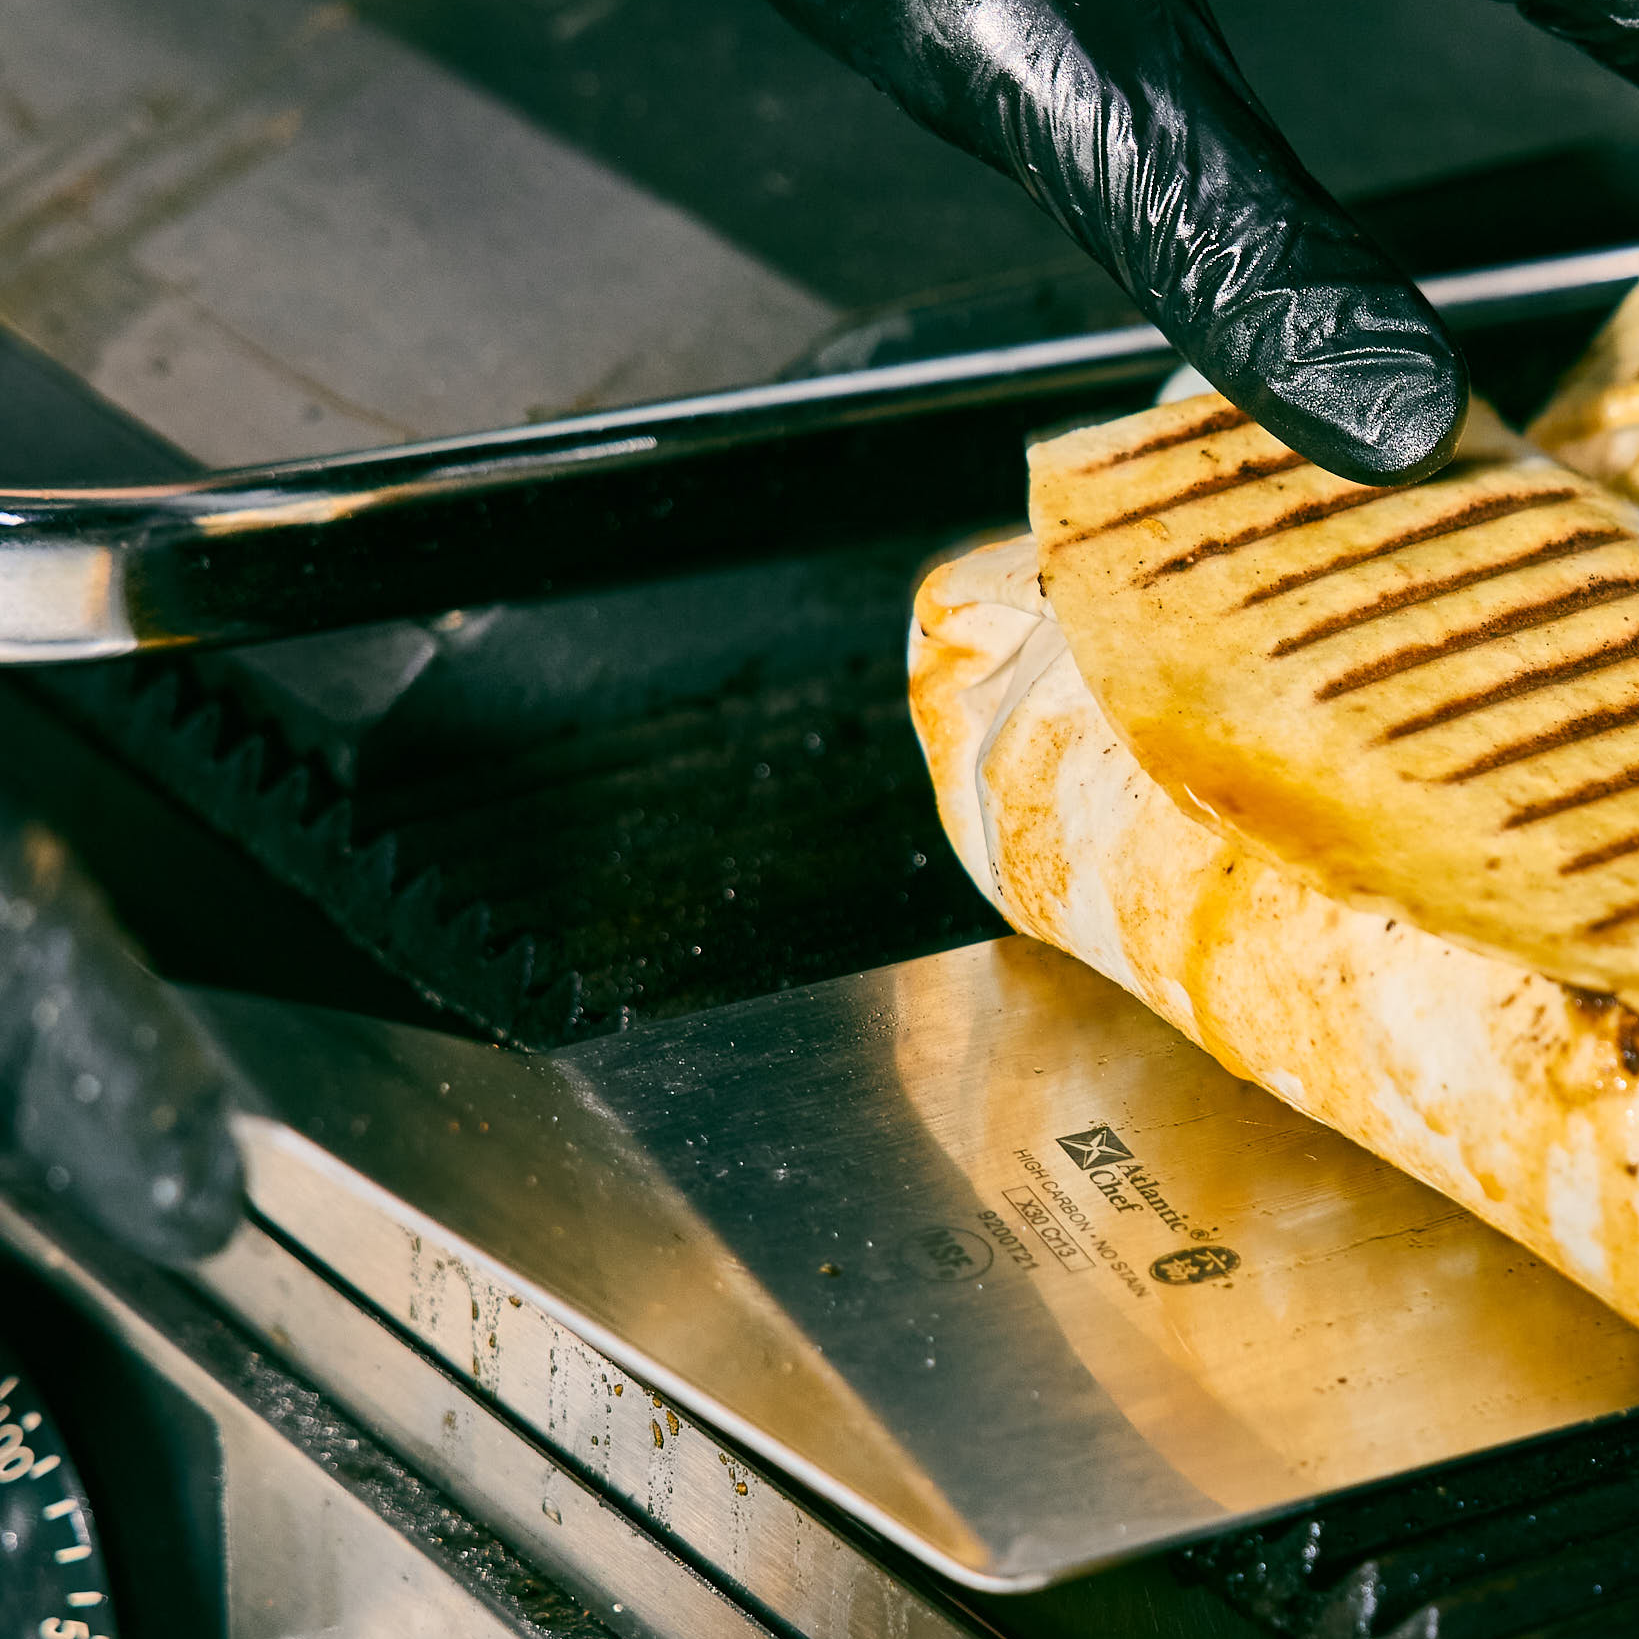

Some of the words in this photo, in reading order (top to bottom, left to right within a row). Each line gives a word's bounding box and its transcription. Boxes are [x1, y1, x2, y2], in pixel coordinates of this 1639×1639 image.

[1089, 1169, 1144, 1213] Chef
[976, 1209, 1041, 1270] 9200T21
[1012, 1148, 1050, 1181] HIGH
[1041, 1181, 1095, 1233] CARBON
[1093, 1239, 1118, 1260] NO
[1110, 1261, 1150, 1298] STAIN
[1015, 1198, 1050, 1225] X30
[1041, 1227, 1077, 1258] Cr13
[0, 1402, 36, 1484] 00
